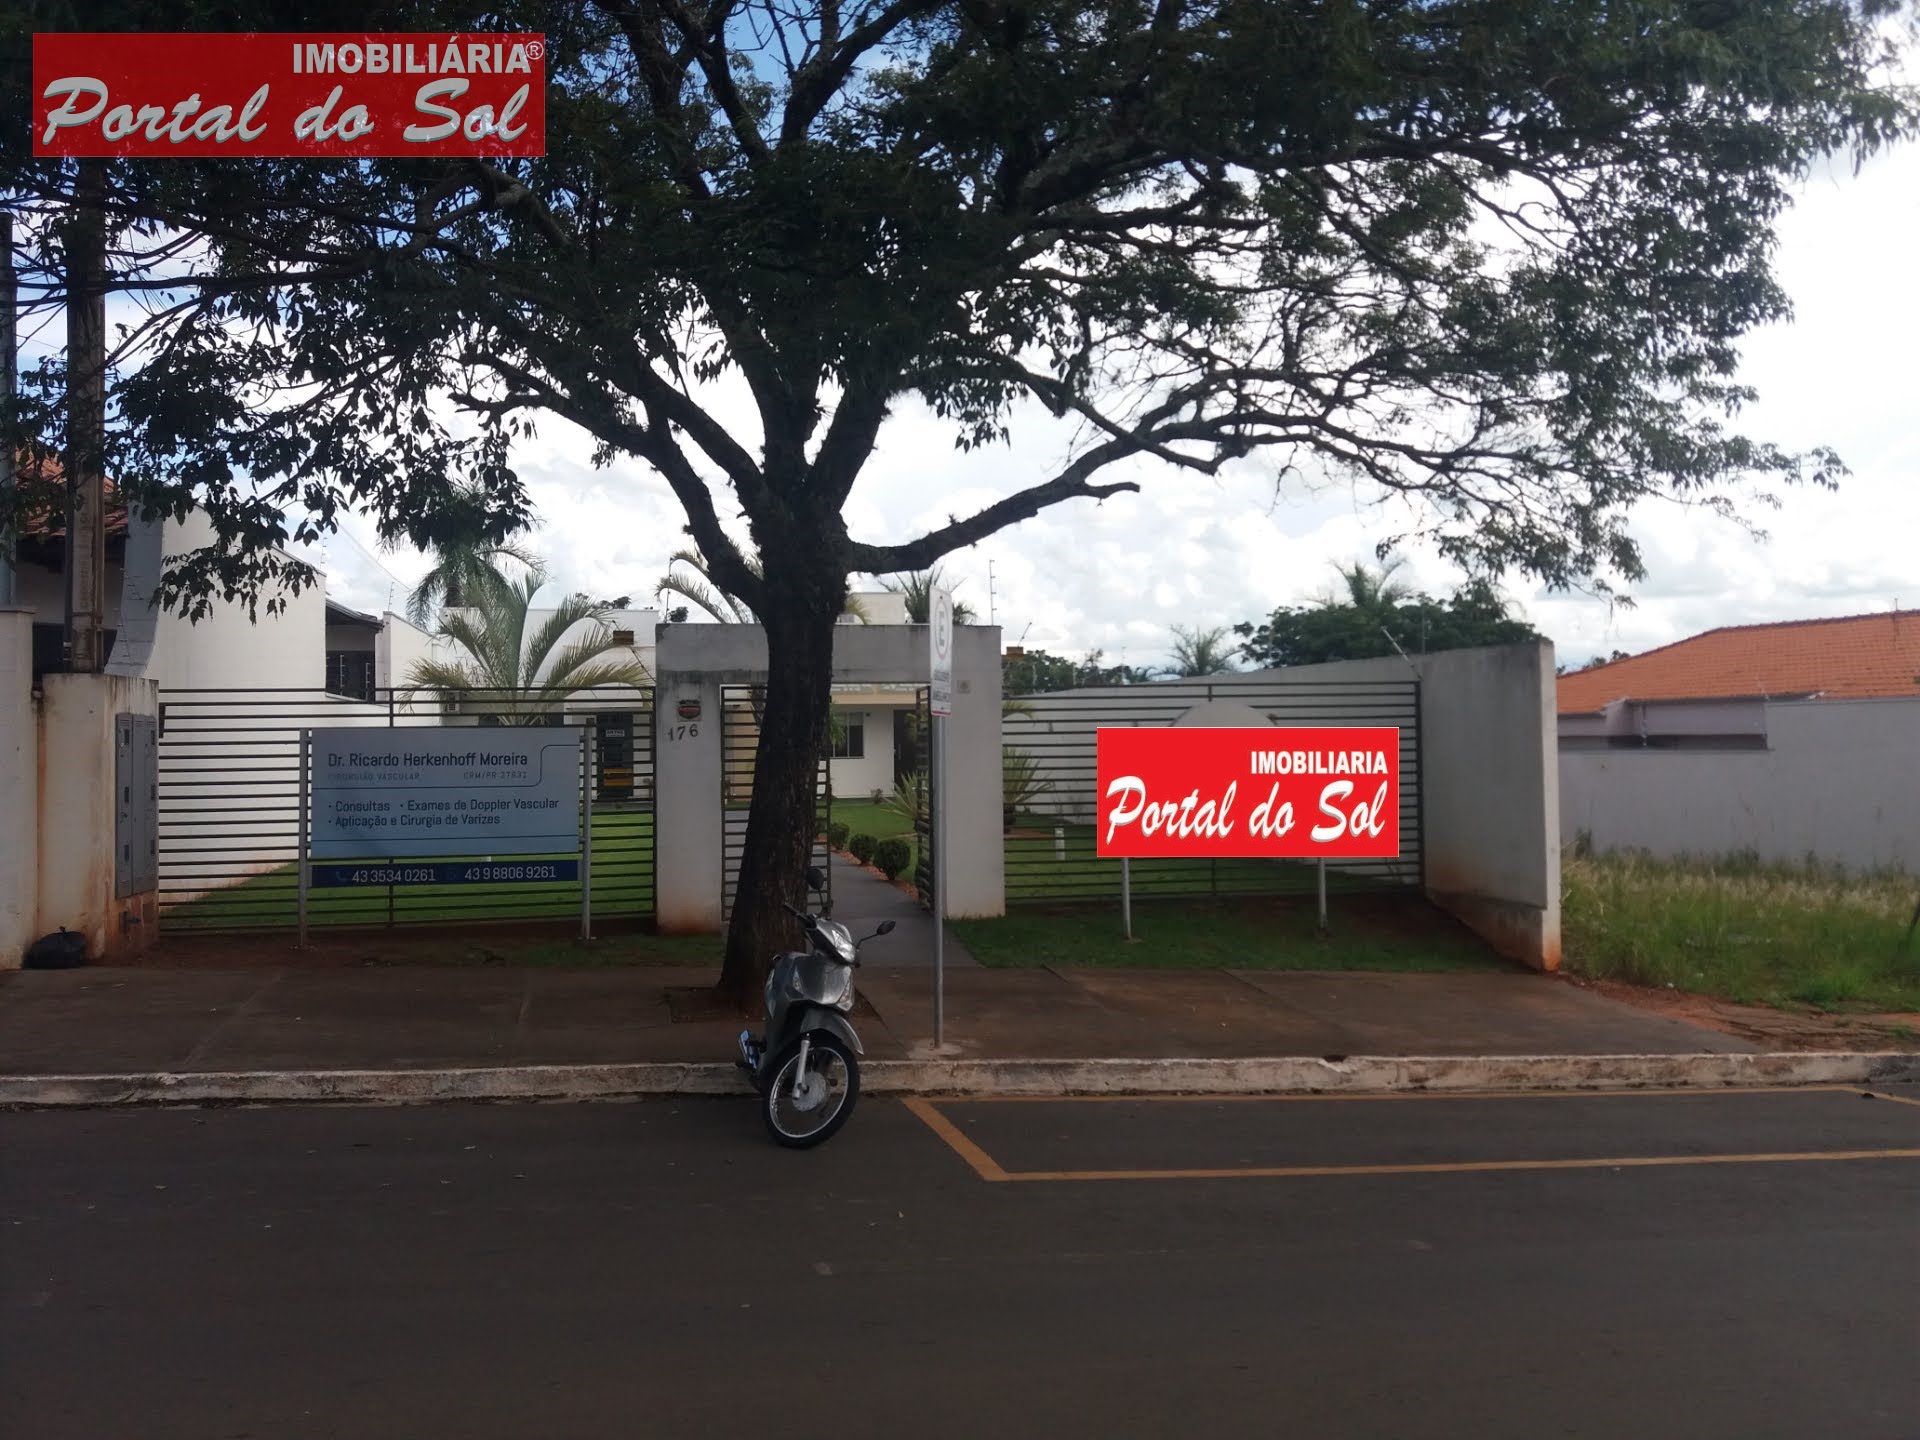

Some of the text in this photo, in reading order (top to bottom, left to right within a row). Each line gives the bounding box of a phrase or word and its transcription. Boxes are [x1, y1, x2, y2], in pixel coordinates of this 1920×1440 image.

[668, 724, 699, 741] 176
[328, 752, 528, 767] Dr. Ricardo Herkenhoff Moreira
[377, 772, 420, 781] VASCULAR
[335, 798, 560, 813] Consultas Exames de Doppler Vascular
[335, 813, 500, 829] Aplicação e Cirurgia de Varizes
[352, 869, 436, 883] 43 3534 0261
[465, 866, 557, 880] 43 9 8806 9261
